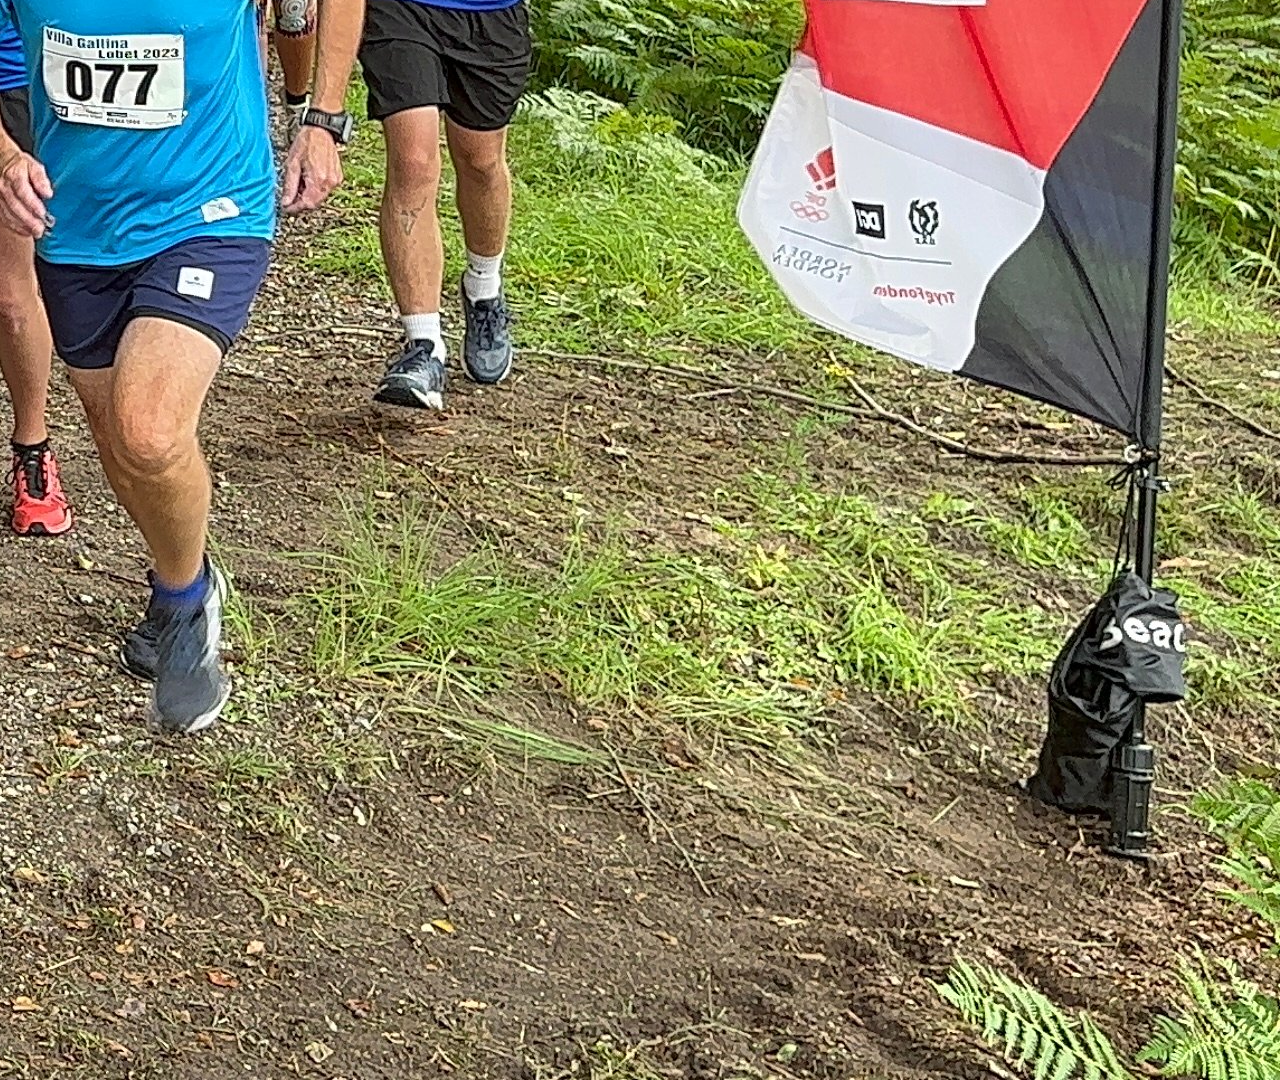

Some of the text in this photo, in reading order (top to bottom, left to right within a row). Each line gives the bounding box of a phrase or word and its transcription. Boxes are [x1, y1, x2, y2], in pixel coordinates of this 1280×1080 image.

[46, 29, 129, 49] Villa Gallina
[143, 48, 179, 58] 2023
[66, 60, 158, 105] 077
